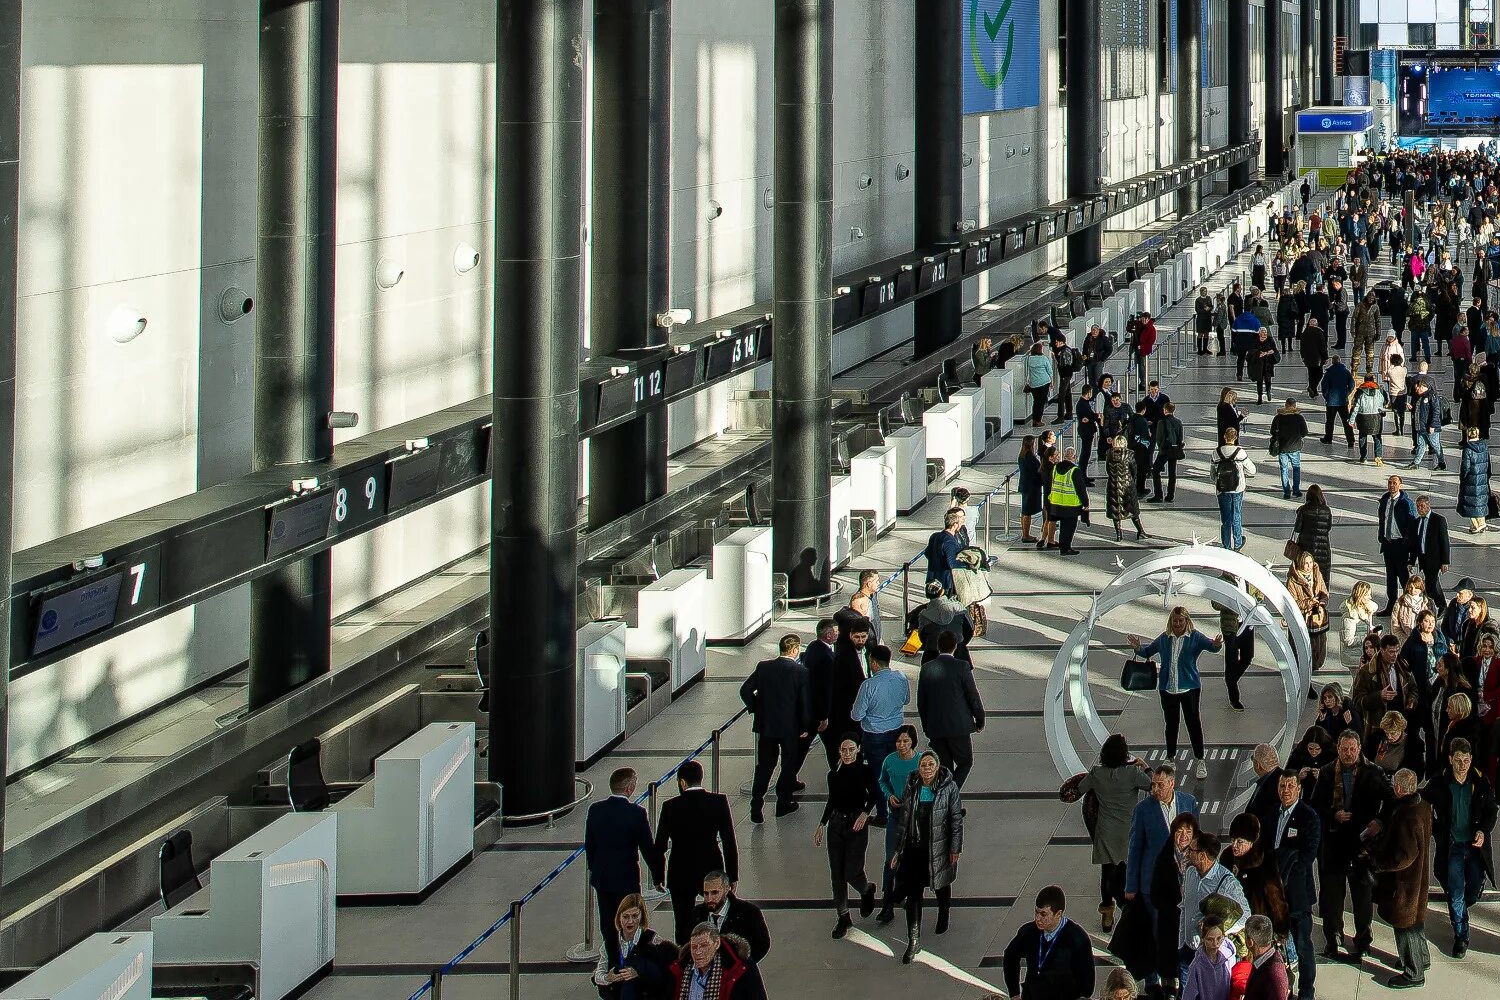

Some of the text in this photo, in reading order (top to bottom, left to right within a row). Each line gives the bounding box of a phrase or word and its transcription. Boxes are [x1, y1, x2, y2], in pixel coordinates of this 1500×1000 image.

[744, 333, 754, 358] 14
[634, 369, 661, 403] 11 12
[335, 476, 377, 522] 8 9
[130, 562, 147, 606] 7
